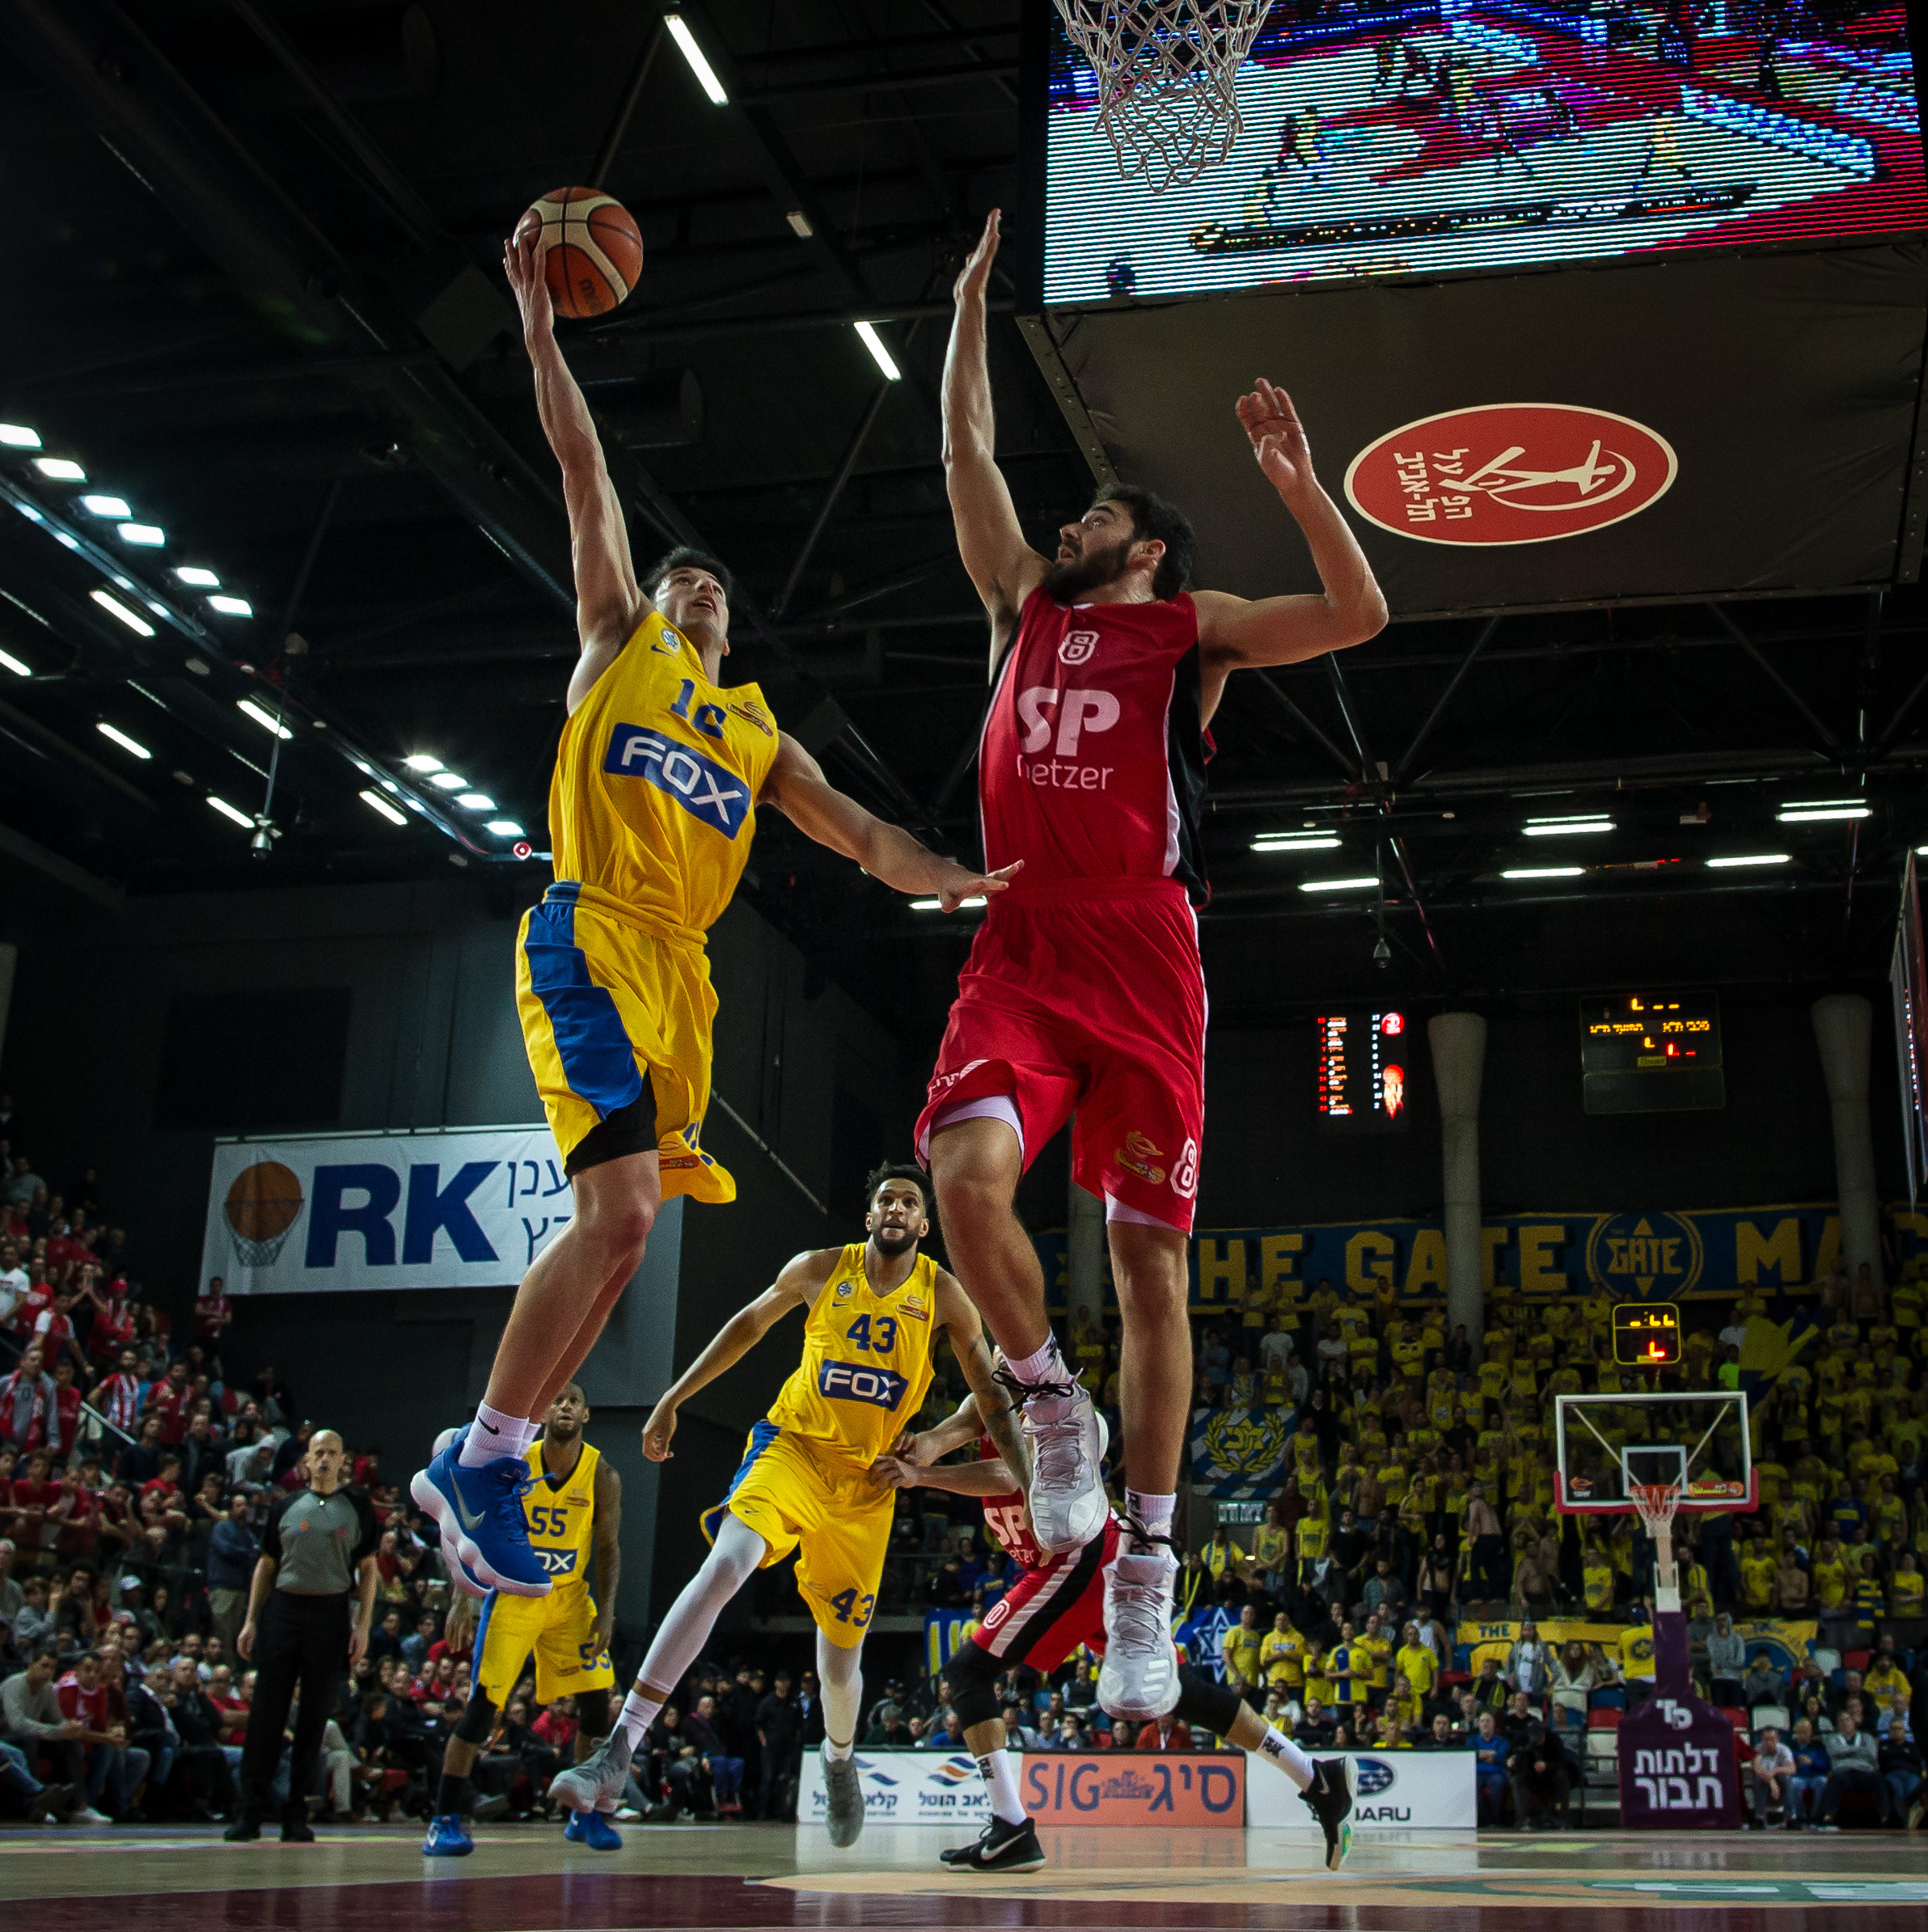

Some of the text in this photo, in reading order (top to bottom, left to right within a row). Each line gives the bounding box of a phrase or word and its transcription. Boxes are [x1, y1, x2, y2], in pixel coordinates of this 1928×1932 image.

[1057, 630, 1100, 666] 8
[1017, 686, 1121, 757] SP
[620, 736, 743, 826] FOX
[507, 1160, 569, 1208] ענן
[1170, 1136, 1198, 1199] 8
[305, 1161, 501, 1268] RK
[1199, 1233, 1304, 1300] HE
[1605, 1237, 1683, 1275] GATE
[846, 1313, 898, 1354] 43
[824, 1368, 900, 1402] FOX
[531, 1506, 569, 1537] 55
[983, 1505, 1027, 1547] SP
[831, 1587, 875, 1628] 43
[1478, 1625, 1511, 1638] THE
[1634, 1741, 1719, 1774] דלתות
[865, 1790, 898, 1809] קלא
[1027, 1762, 1099, 1812] SIG
[1148, 1763, 1237, 1813] סיג
[1634, 1776, 1724, 1810] תבור
[1355, 1806, 1411, 1821] ARU
